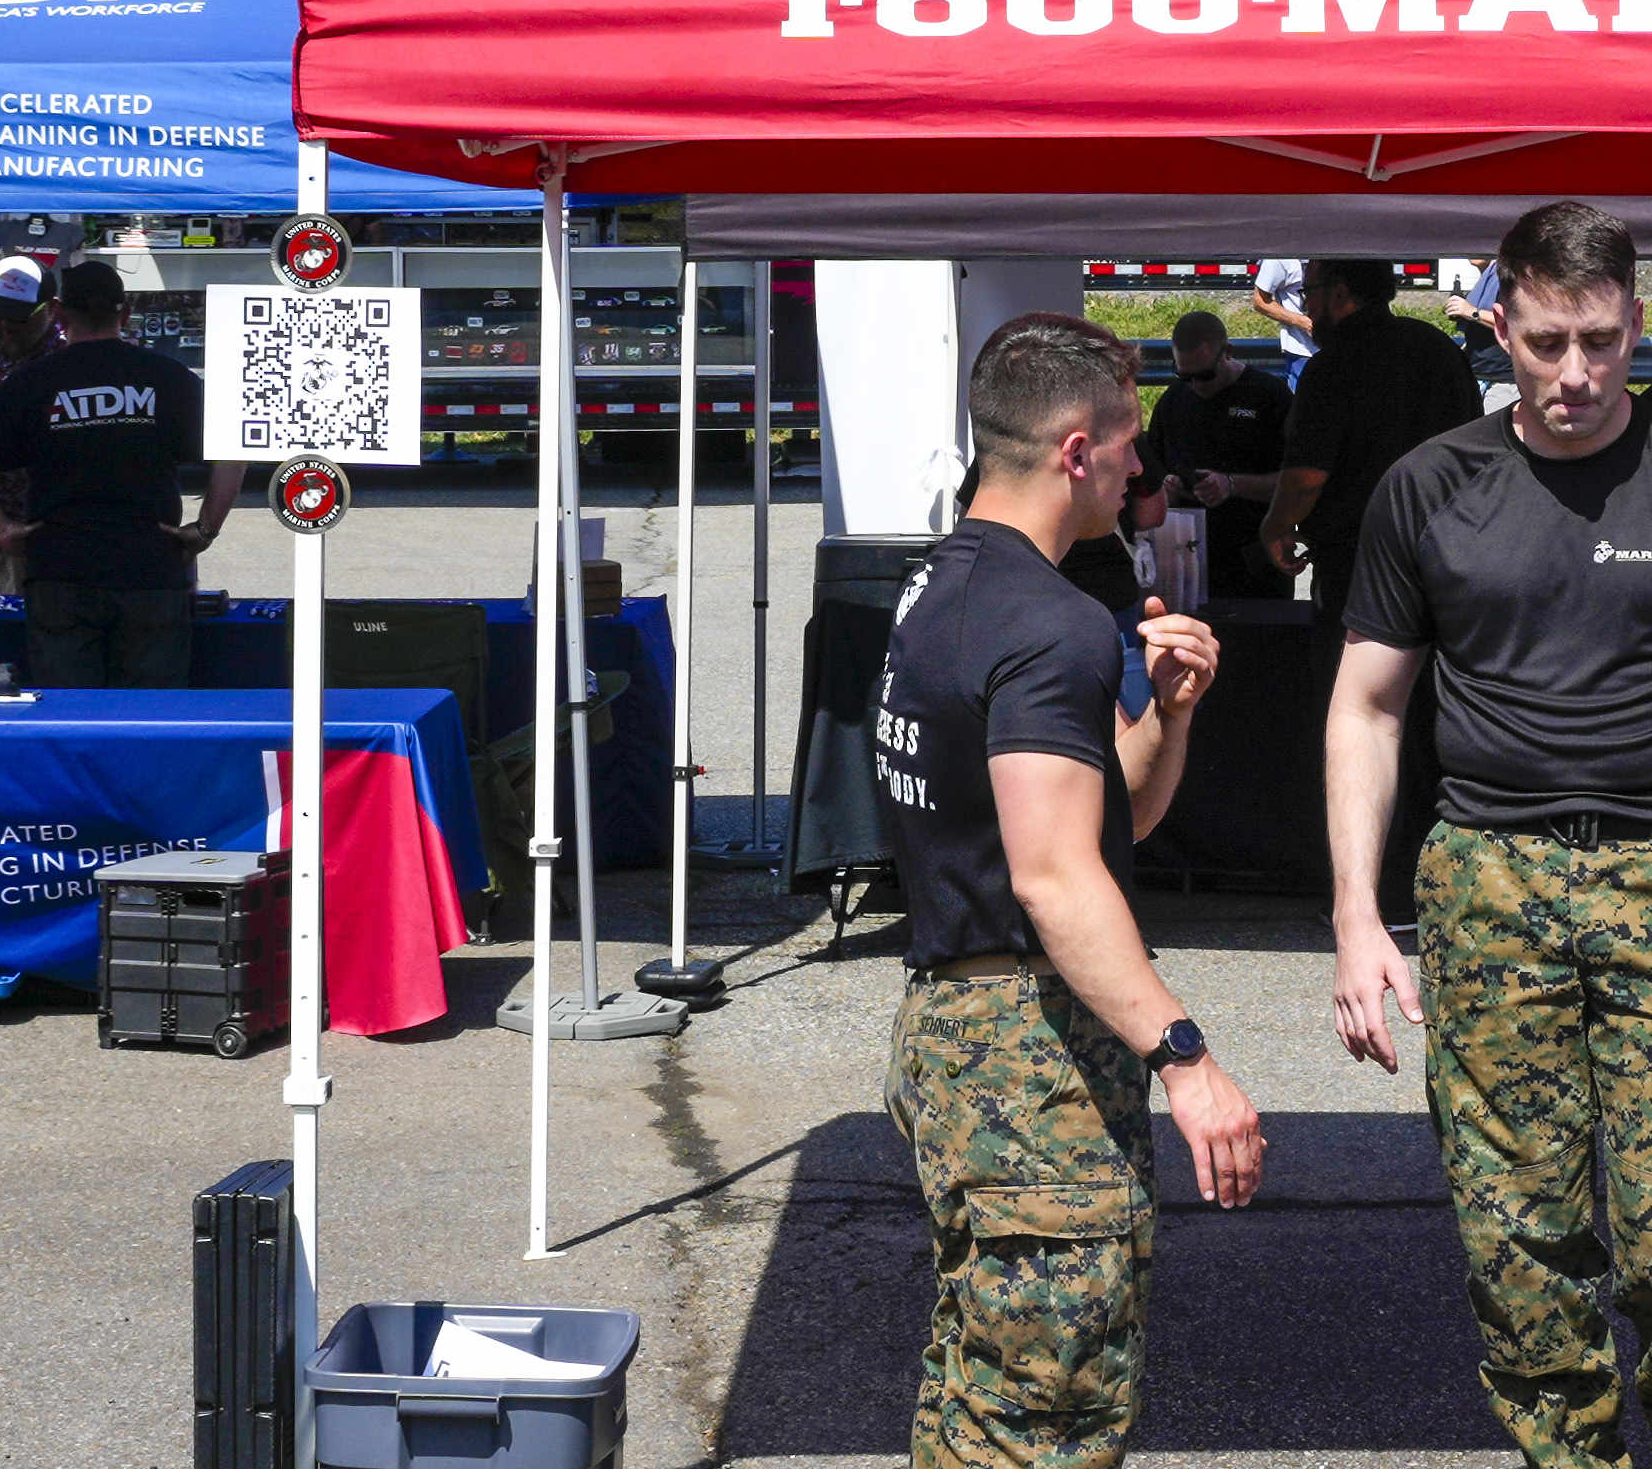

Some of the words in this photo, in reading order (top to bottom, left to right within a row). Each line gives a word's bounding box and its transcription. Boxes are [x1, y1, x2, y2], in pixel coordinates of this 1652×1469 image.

[45, 1, 206, 19] WORKFORCE
[108, 125, 140, 148] IN
[147, 126, 266, 149] DEFENSE
[284, 220, 314, 240] UNITED
[49, 385, 157, 423] ATDM
[279, 461, 306, 484] UNITED
[308, 461, 337, 479] STATES
[282, 508, 314, 529] MARINE
[352, 620, 389, 634] ULINE
[31, 851, 65, 874] IN
[77, 837, 209, 870] DEFENSE
